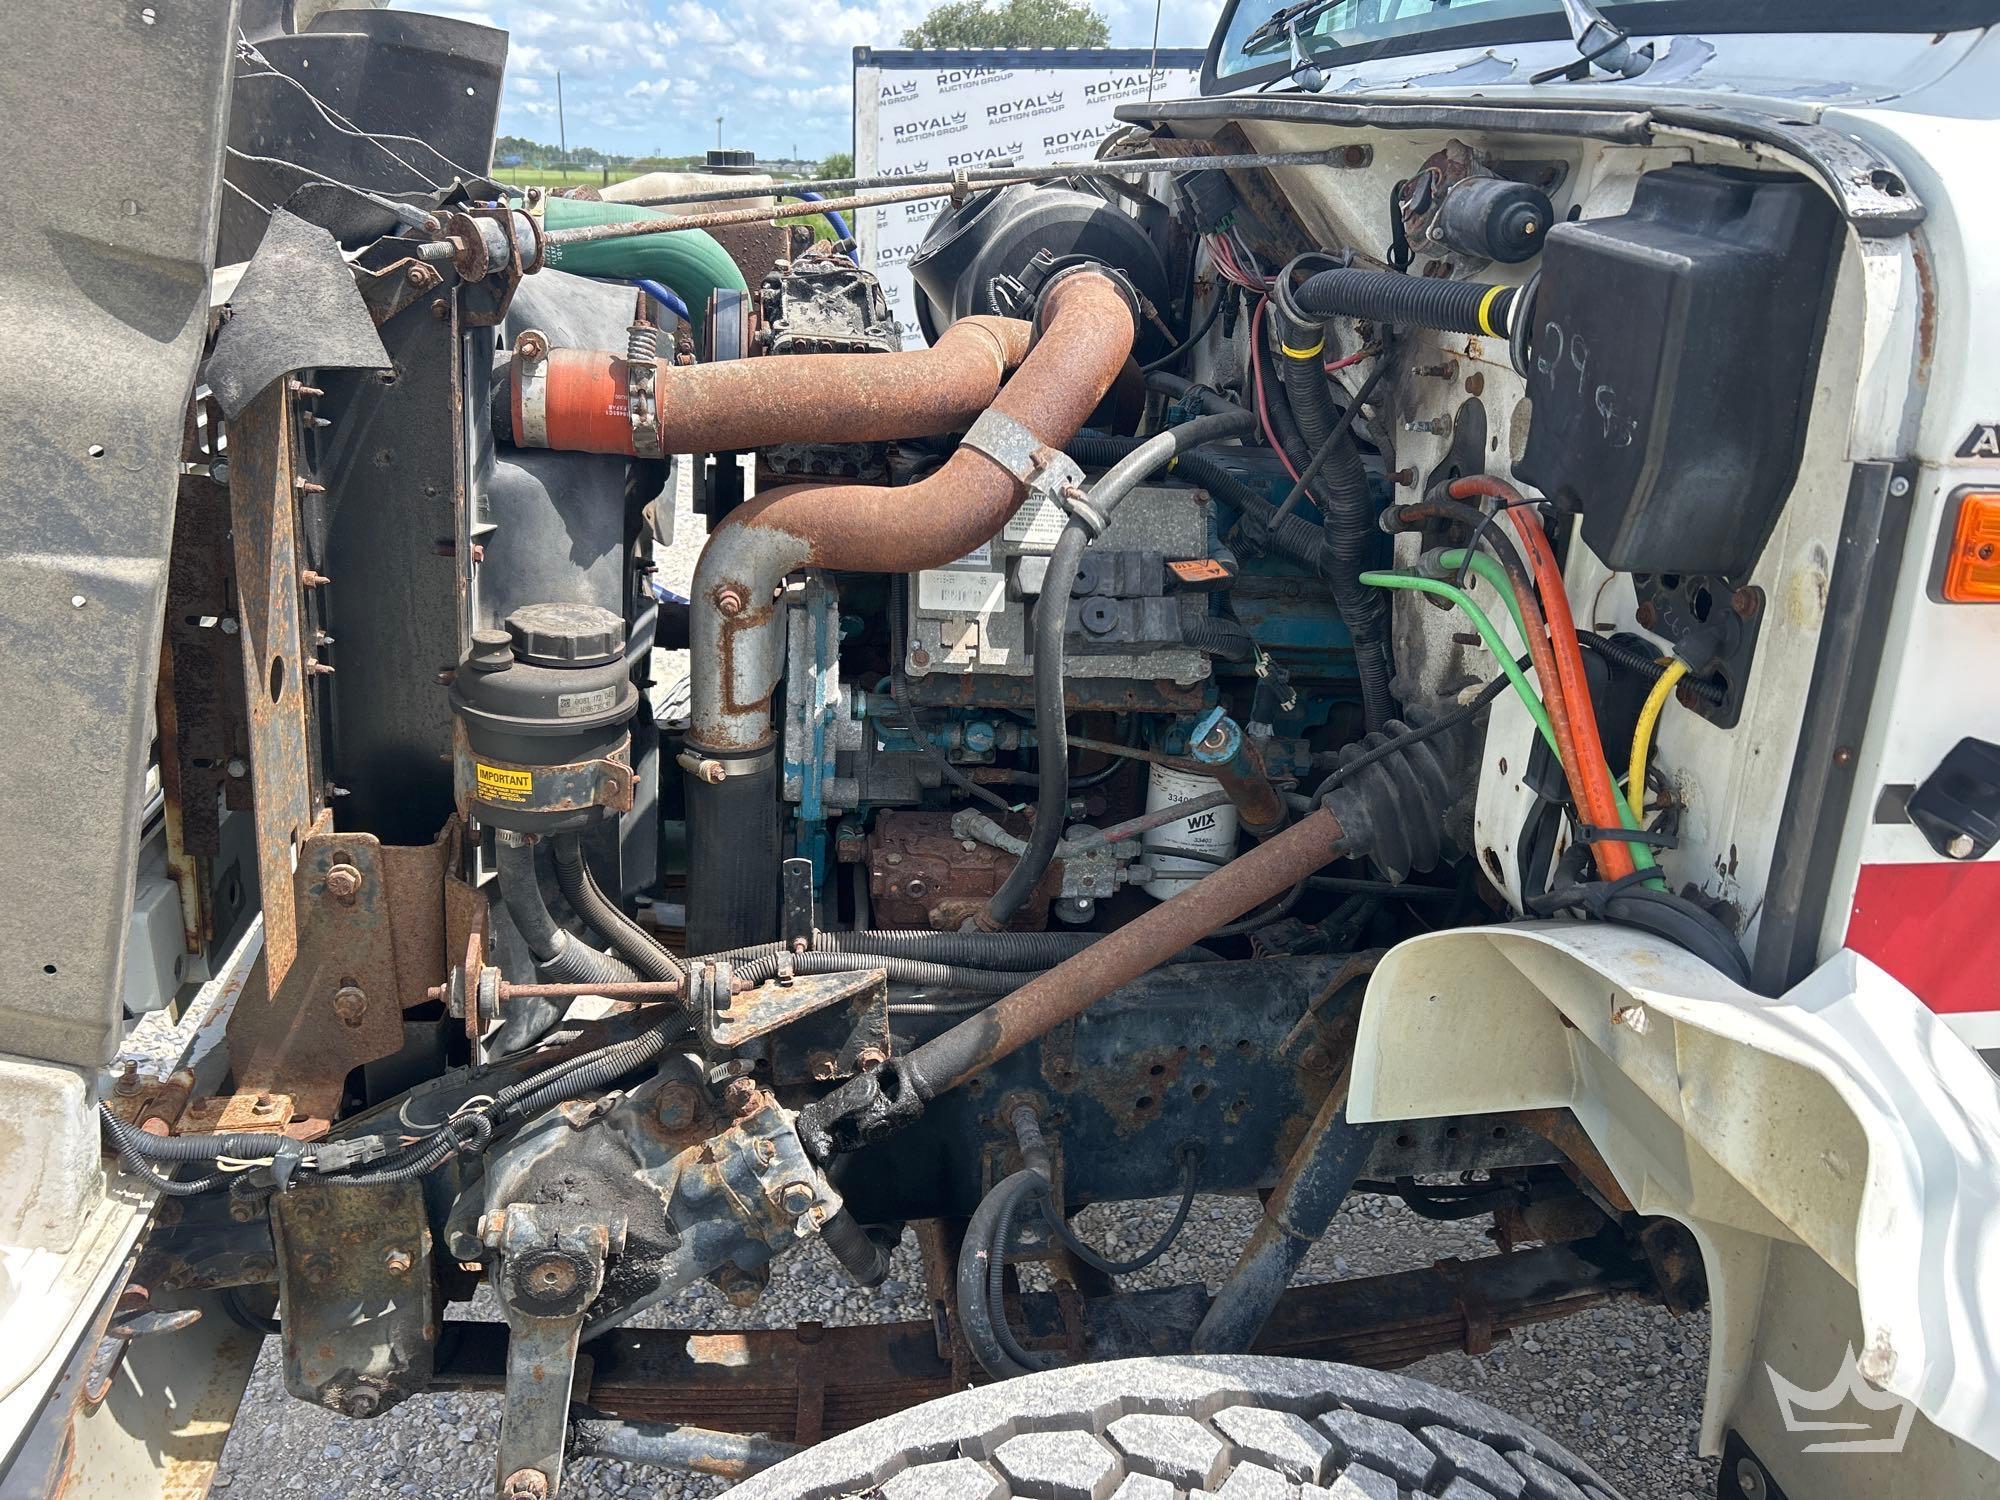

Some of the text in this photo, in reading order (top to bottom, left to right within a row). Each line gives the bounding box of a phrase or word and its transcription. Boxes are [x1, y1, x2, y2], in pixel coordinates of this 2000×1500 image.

[939, 72, 1014, 94] AUCTION GROUP
[1085, 74, 1148, 96] ROYAL
[1087, 82, 1167, 105] AUCTION GROUP
[888, 93, 919, 105] GROUP
[987, 96, 1047, 117] ROYAL
[989, 104, 1065, 126] AUCTION GROUP
[894, 116, 951, 136] ROYAL
[896, 124, 968, 145] AUCTION GROUP
[1043, 126, 1105, 148] ROYAL
[948, 146, 1006, 167] ROYAL
[1045, 141, 1088, 156] AUCTION
[906, 198, 949, 215] ROYA
[479, 769, 529, 786] IMPORTANT
[1167, 793, 1194, 803] 3340
[1187, 812, 1215, 830] WIX
